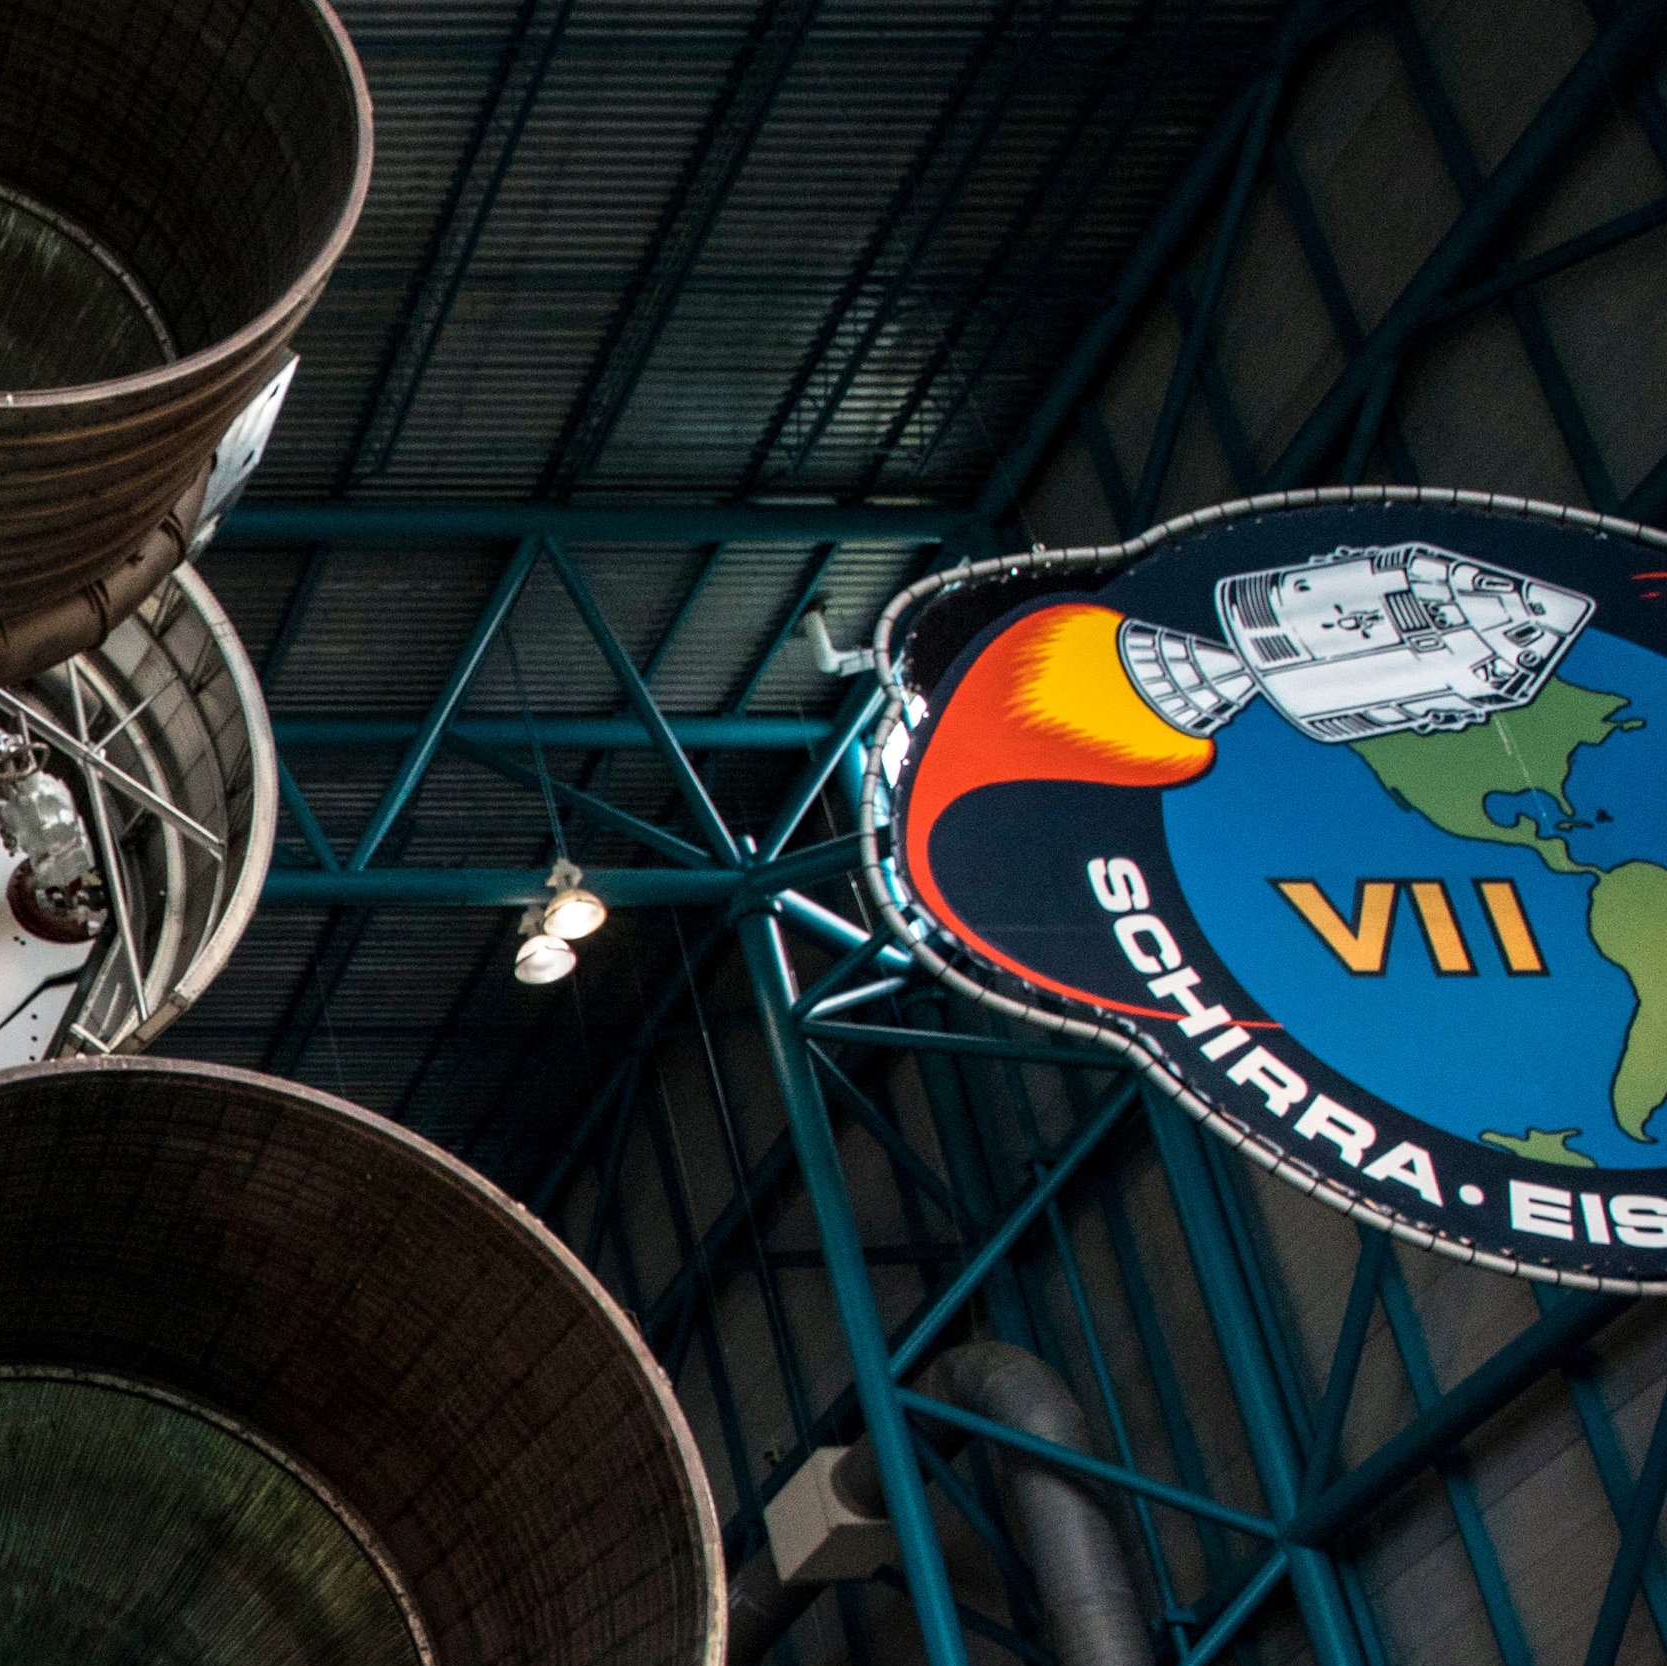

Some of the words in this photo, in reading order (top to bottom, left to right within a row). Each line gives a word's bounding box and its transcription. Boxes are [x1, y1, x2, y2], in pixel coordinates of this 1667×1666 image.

[1268, 878, 1551, 977] VII
[1087, 857, 1444, 1207] SCHIRRA
[1509, 1179, 1667, 1248] EIS
